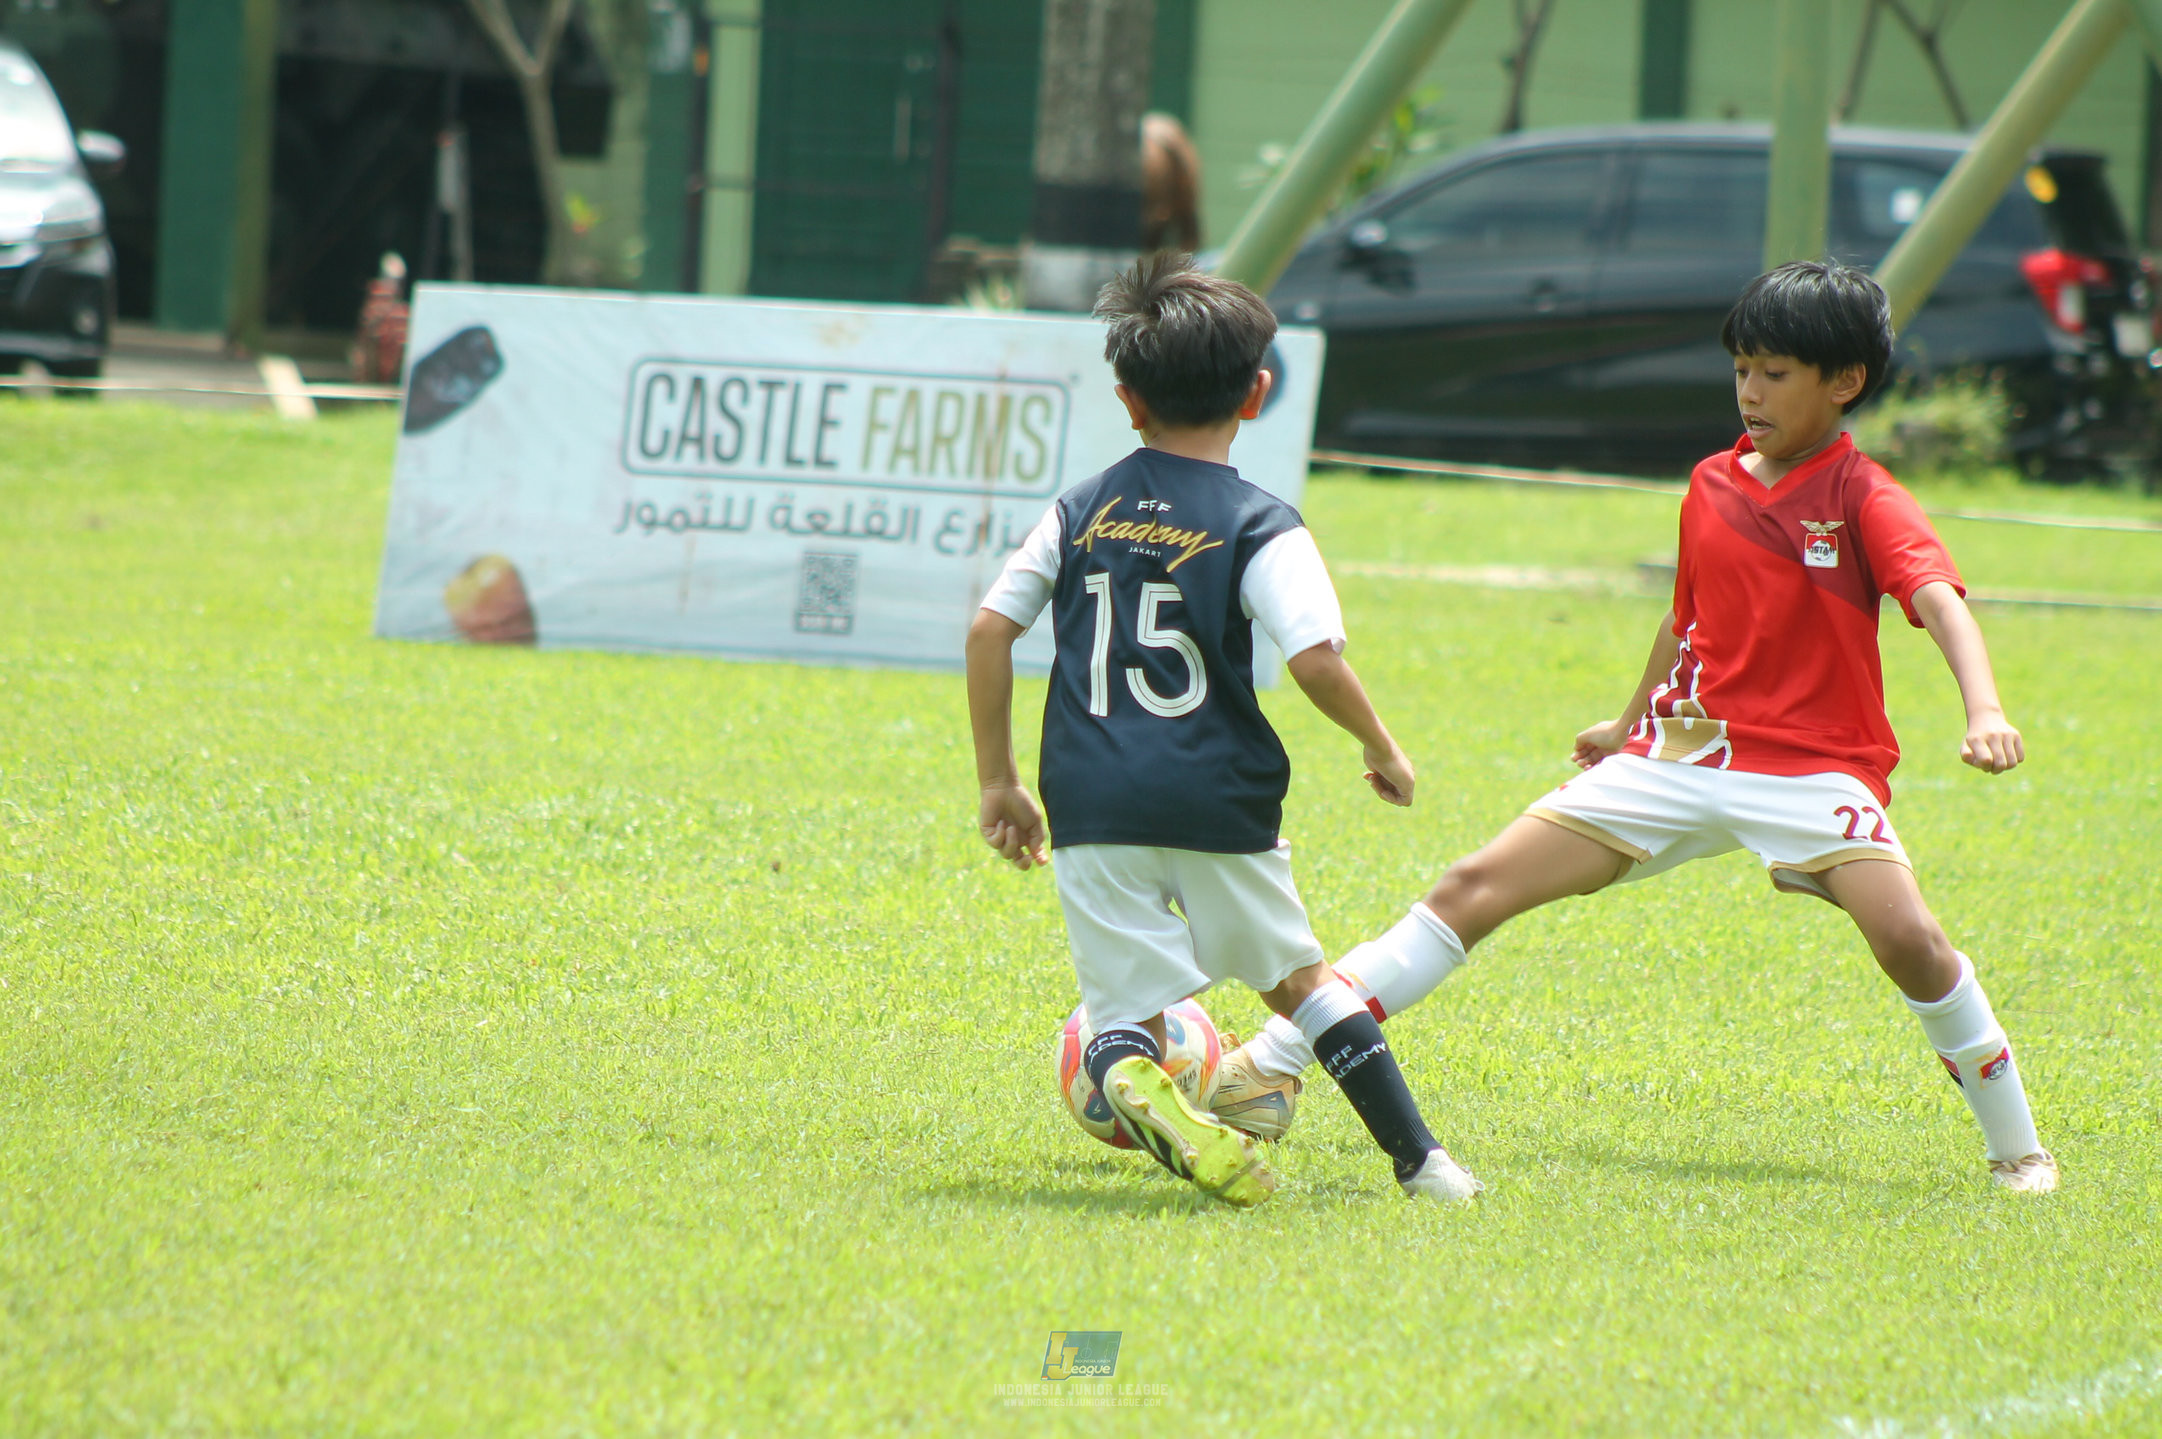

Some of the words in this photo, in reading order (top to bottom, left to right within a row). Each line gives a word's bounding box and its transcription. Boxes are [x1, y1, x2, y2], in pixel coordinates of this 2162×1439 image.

[639, 371, 848, 468] CASTLE
[860, 385, 1053, 484] FARMS
[612, 491, 756, 536] للتمور
[768, 490, 920, 545] القلعة
[1137, 499, 1172, 512] FFF
[1073, 495, 1225, 574] Academy
[1084, 571, 1208, 718] 15
[1833, 805, 1894, 845] 22
[1325, 1044, 1353, 1074] FFF
